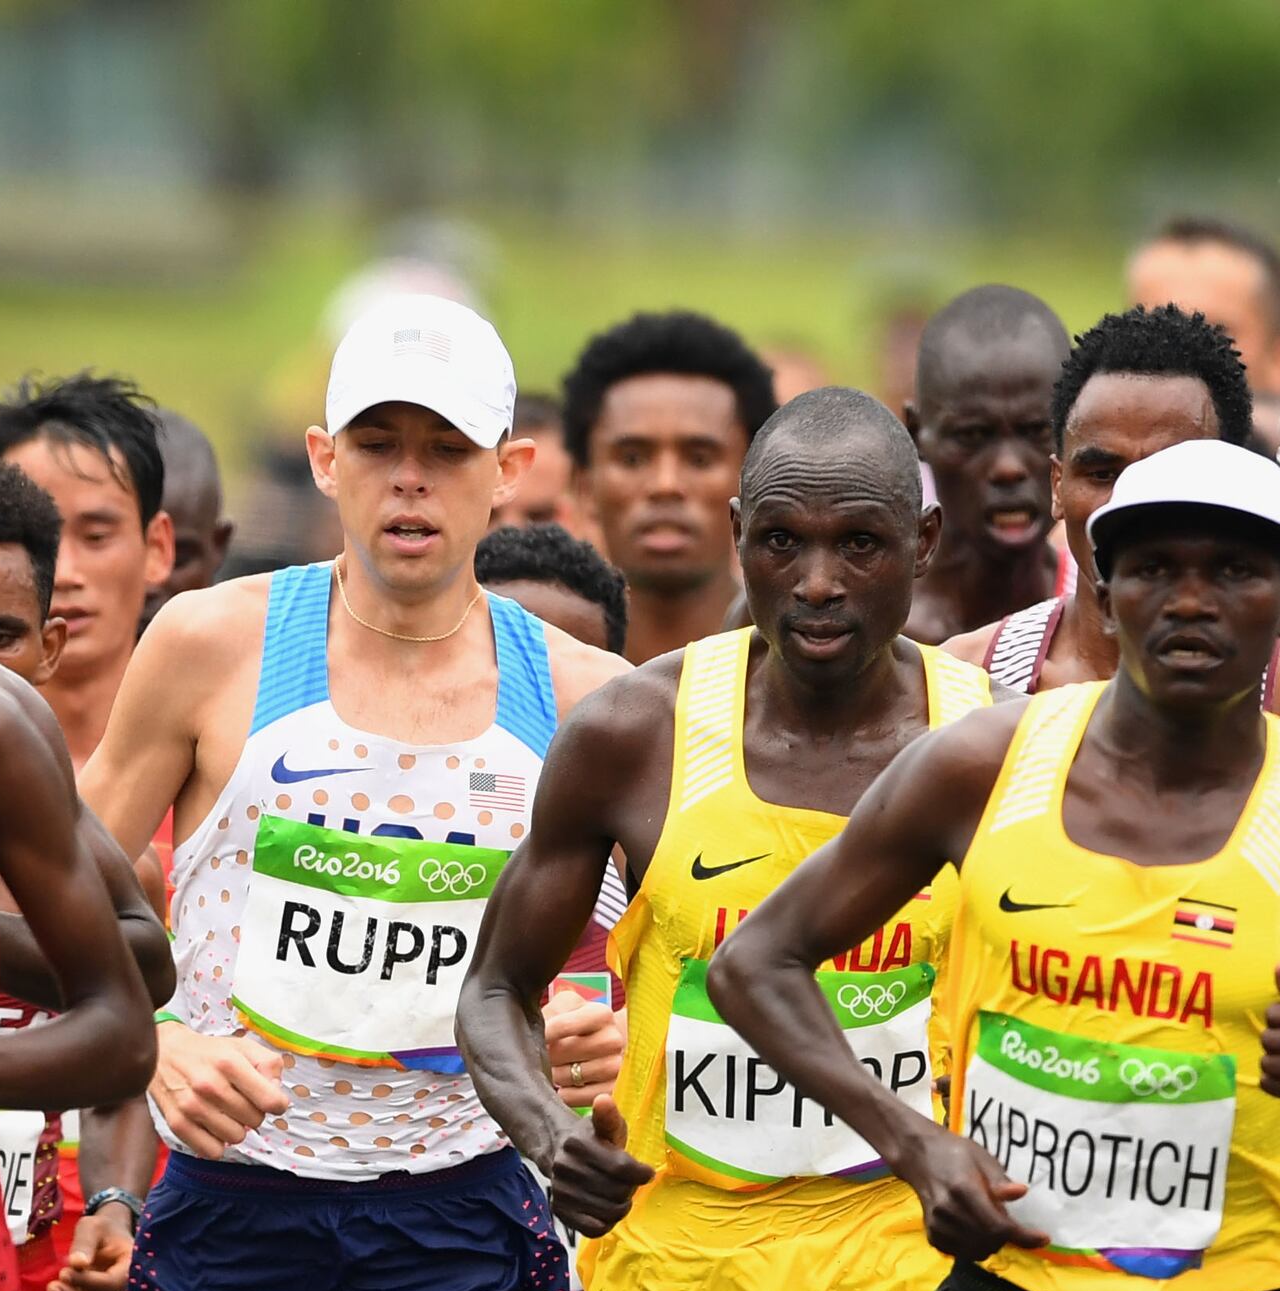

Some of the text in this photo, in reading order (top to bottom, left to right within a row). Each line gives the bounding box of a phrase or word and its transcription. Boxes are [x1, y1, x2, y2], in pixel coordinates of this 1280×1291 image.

[293, 844, 401, 885] Rio2016
[275, 900, 468, 985] RUPP
[1010, 939, 1214, 1029] UGANDA
[999, 1030, 1101, 1084] Rio2016
[968, 1088, 1218, 1212] KIPROTICH
